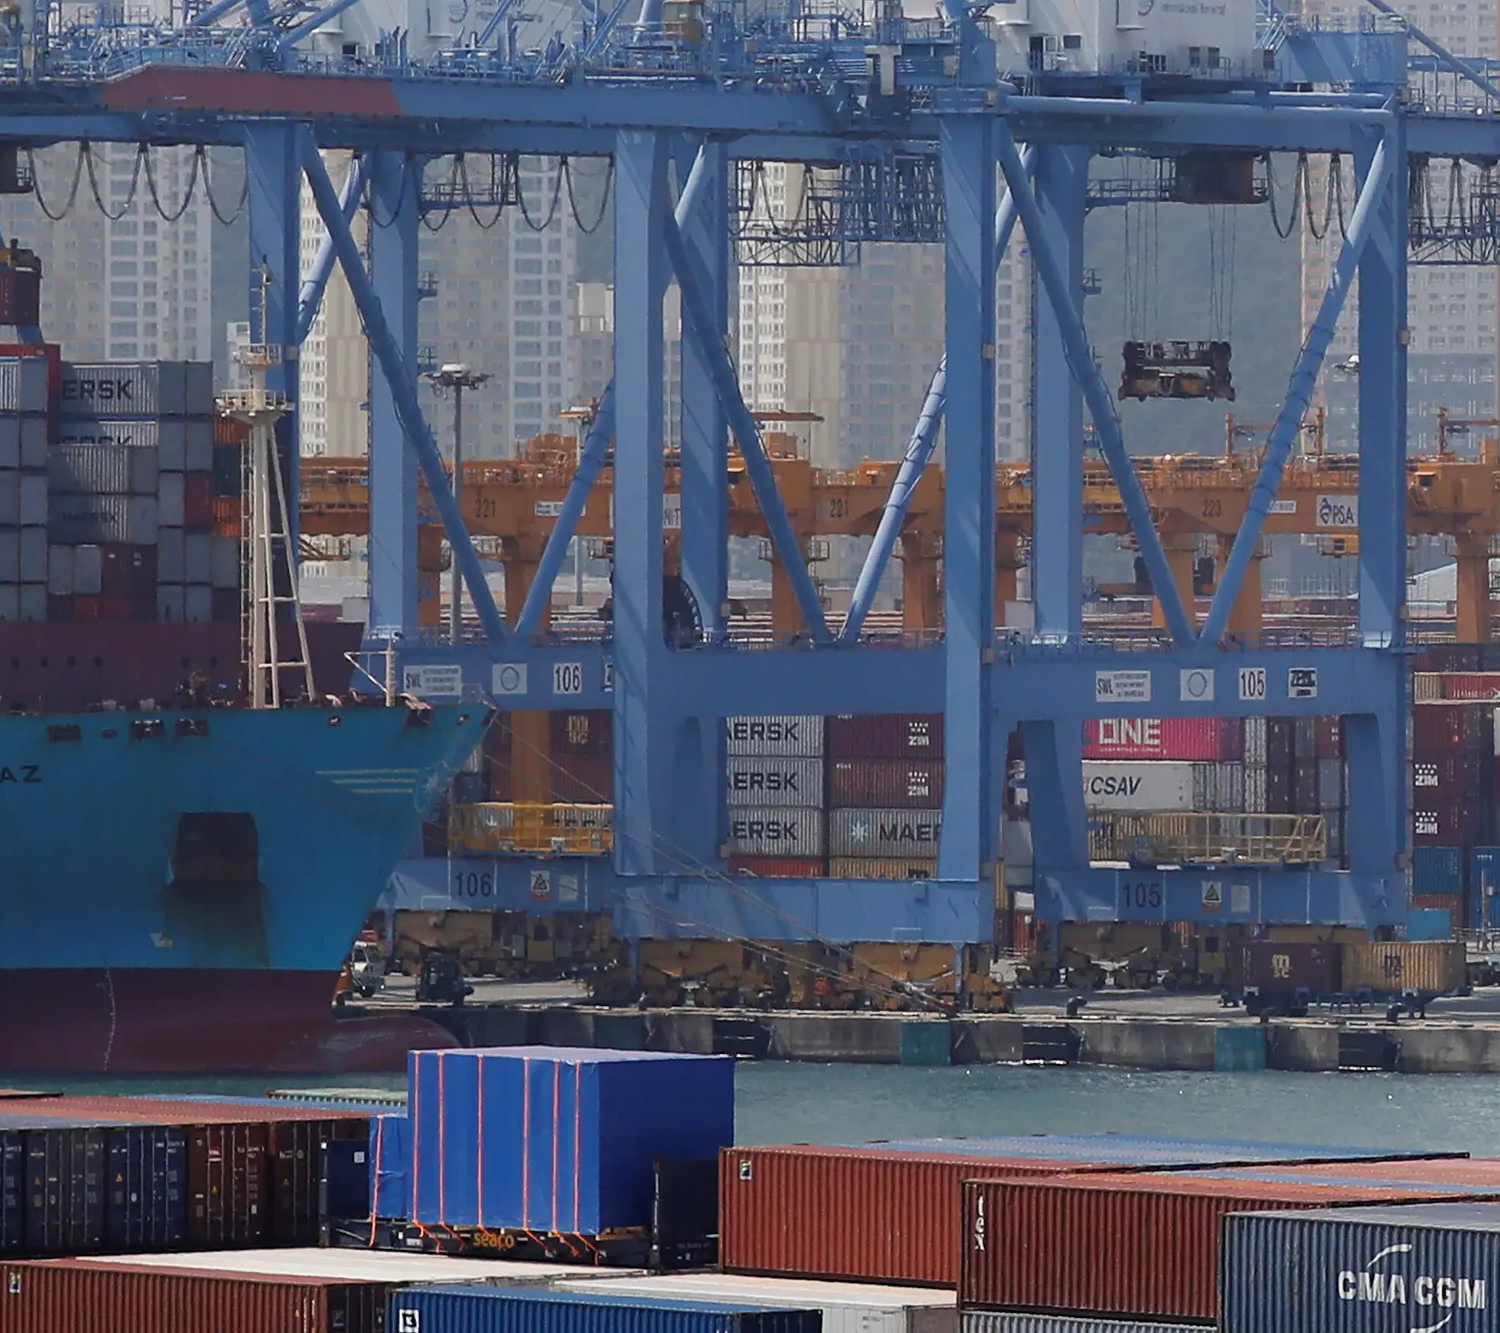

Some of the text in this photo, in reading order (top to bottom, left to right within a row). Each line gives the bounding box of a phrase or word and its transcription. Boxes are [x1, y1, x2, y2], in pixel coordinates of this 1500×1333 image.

[555, 665, 581, 692] 106
[1241, 670, 1265, 697] 105
[727, 722, 798, 741] ERSK
[1099, 718, 1161, 745] ONE
[728, 771, 799, 791] ERSK
[1091, 776, 1142, 796] CSAV
[728, 821, 798, 841] ERSK
[455, 872, 492, 897] 106
[1123, 883, 1161, 908] 105
[473, 1231, 515, 1249] seaco
[1338, 1270, 1486, 1310] CMA CGM
